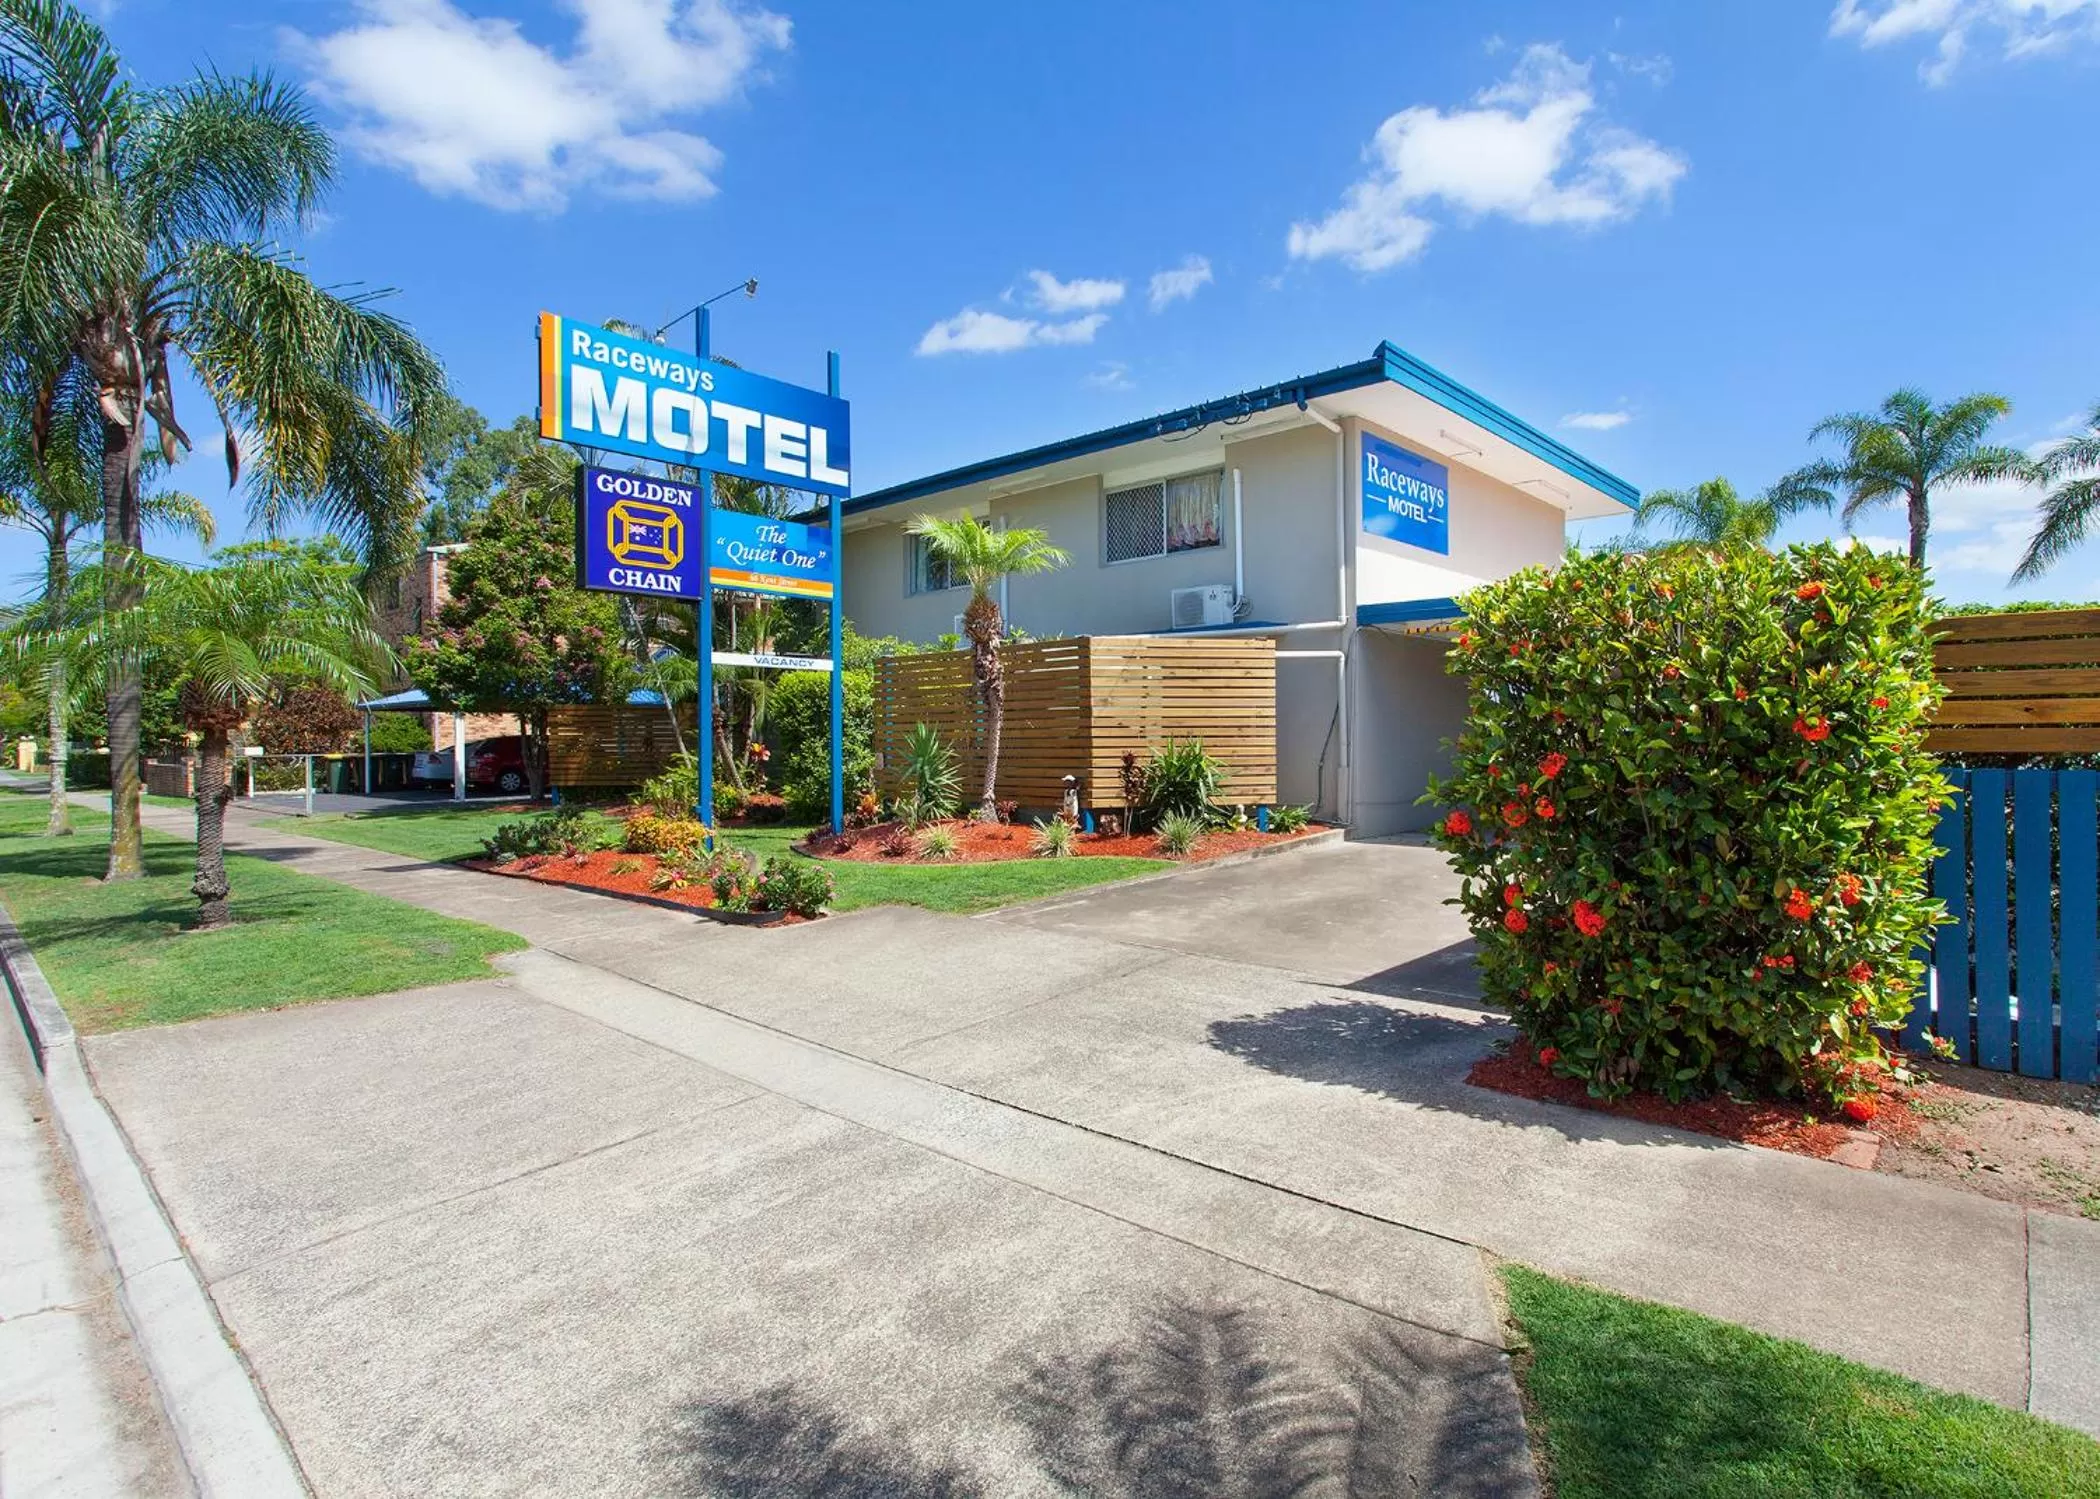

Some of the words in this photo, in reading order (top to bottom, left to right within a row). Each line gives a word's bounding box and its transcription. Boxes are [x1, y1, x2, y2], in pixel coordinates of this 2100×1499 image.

[572, 329, 714, 392] Raceways
[571, 364, 849, 487] MOTEL
[596, 474, 693, 507] GOLDEN
[1366, 452, 1444, 513] Raceways
[1388, 495, 1428, 523] MOTEL
[755, 525, 787, 545] The
[608, 567, 682, 592] CHAIN
[754, 656, 815, 668] VACANCY
